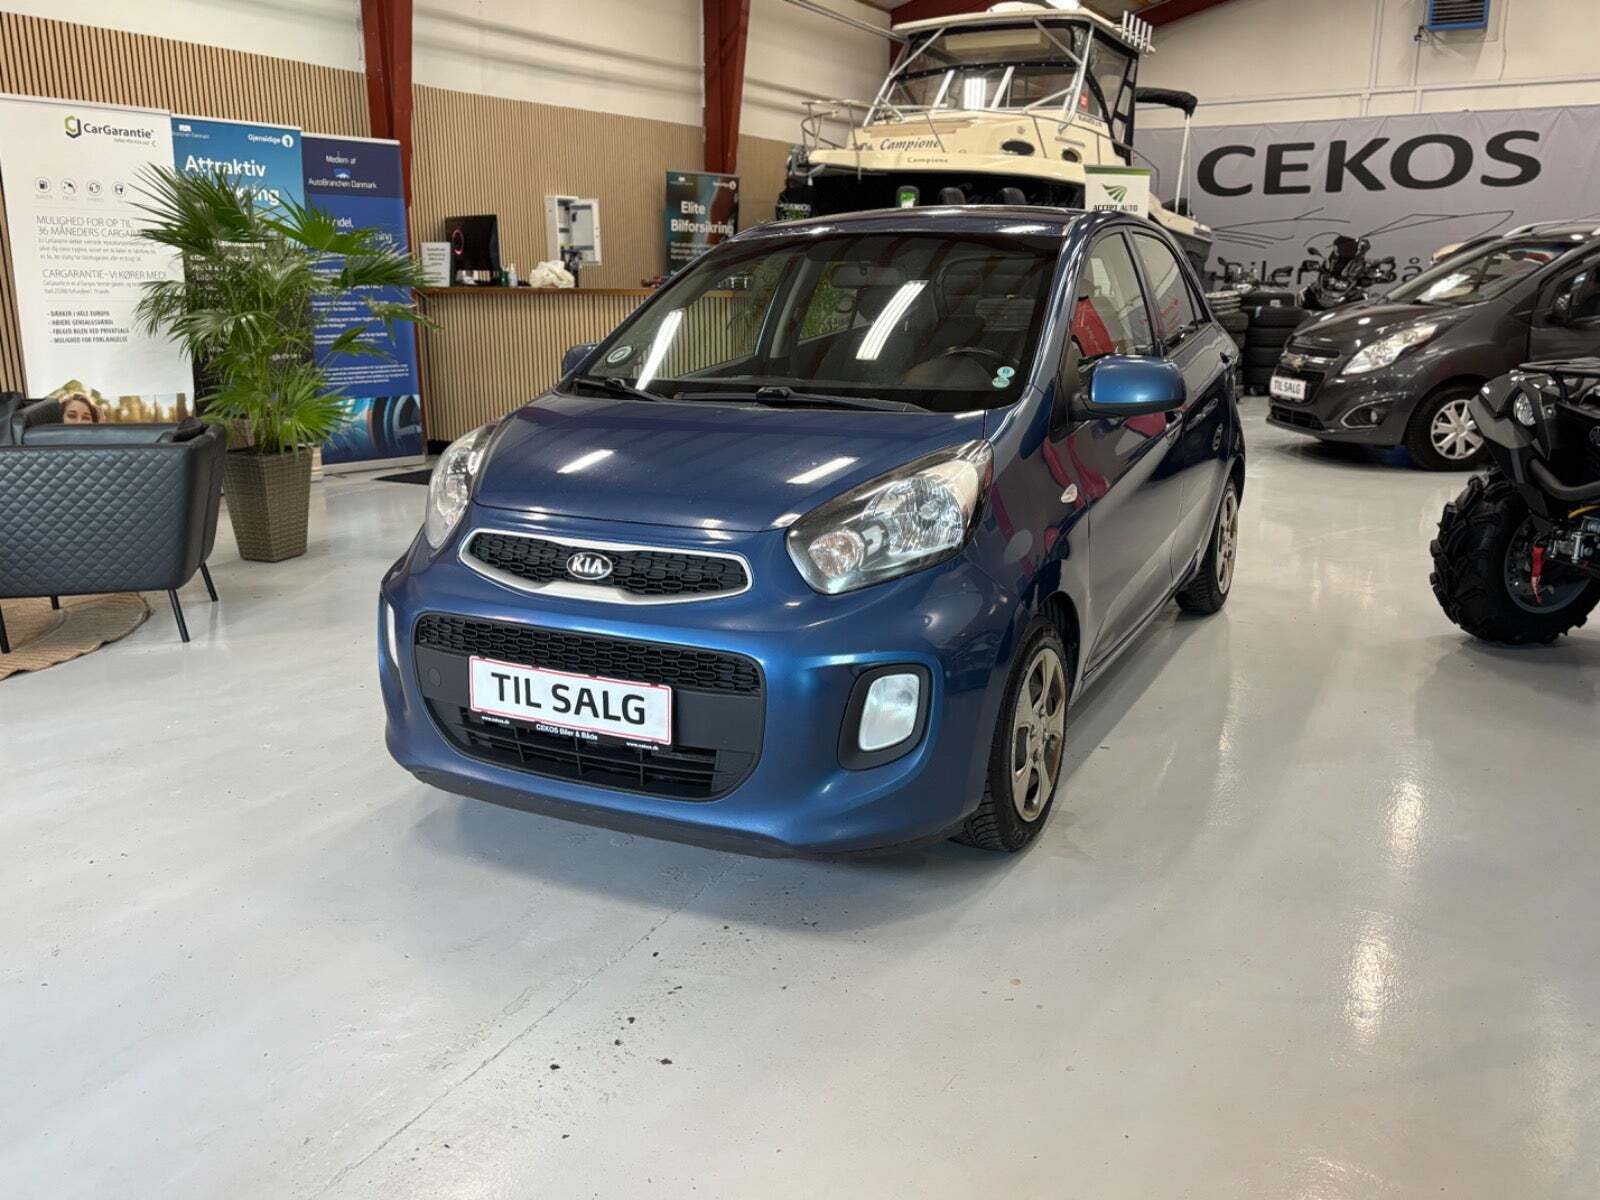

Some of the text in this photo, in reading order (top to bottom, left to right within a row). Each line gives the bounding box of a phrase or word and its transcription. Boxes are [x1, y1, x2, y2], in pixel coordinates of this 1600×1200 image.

[84, 123, 152, 139] CarGarantie
[880, 138, 939, 151] Campione
[185, 155, 266, 177] Attraktiv
[1197, 130, 1542, 197] CEKOS
[680, 201, 706, 215] Elite
[670, 219, 734, 237] Bilforsikring
[1283, 381, 1302, 394] SALG
[572, 555, 603, 574] KIA
[491, 672, 645, 725] TIL SALG
[535, 723, 559, 735] CEKOS
[559, 726, 574, 737] Biler
